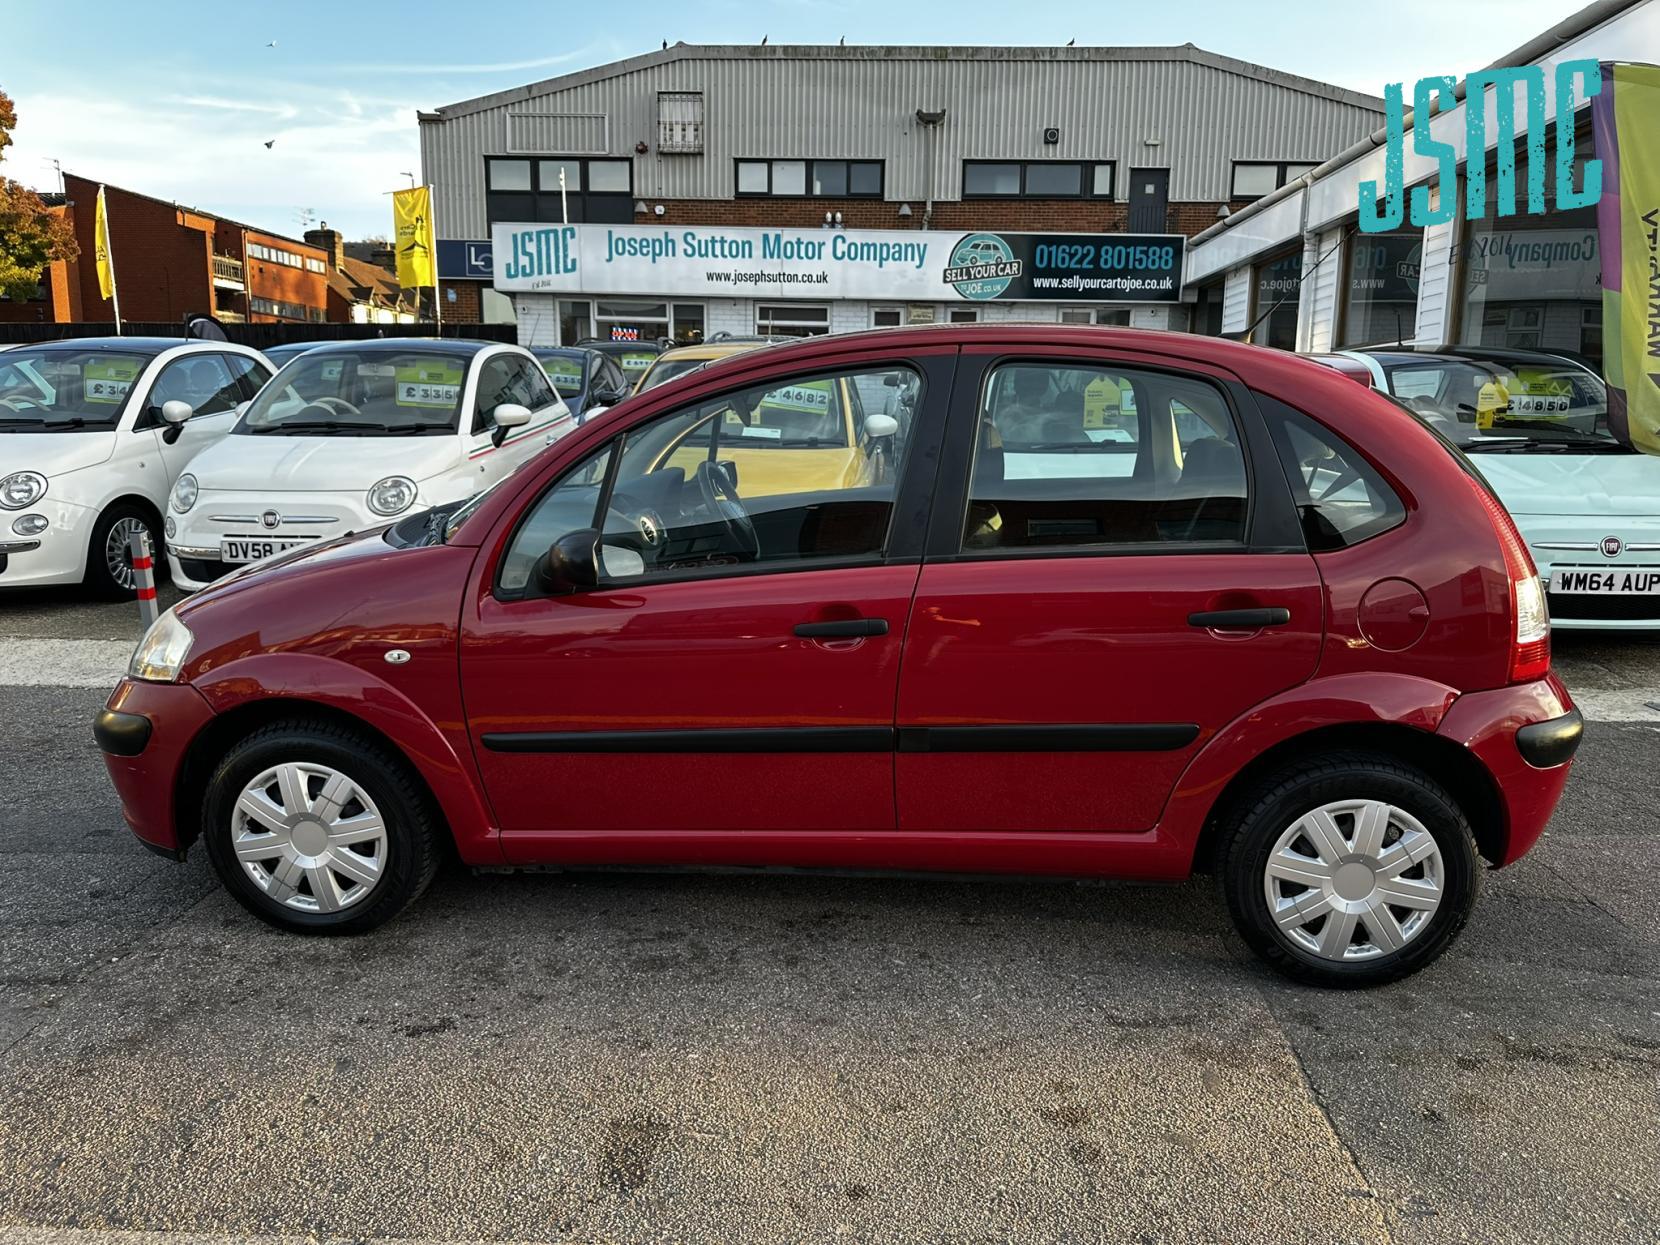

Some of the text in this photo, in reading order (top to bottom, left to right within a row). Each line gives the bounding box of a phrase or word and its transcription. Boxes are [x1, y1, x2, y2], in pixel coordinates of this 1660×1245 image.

[505, 226, 577, 279] JSMC
[606, 230, 928, 269] Joseph Sutton Motor Company
[1035, 244, 1174, 270] 01622 801588
[706, 269, 828, 286] www.josephsutton.co.uk
[945, 262, 1018, 282] SELL YOUR CAR
[1033, 275, 1173, 292] www.sellyourcartojoe.co.uk
[228, 542, 273, 559] DV58
[1561, 573, 1660, 591] WM64 AUP
